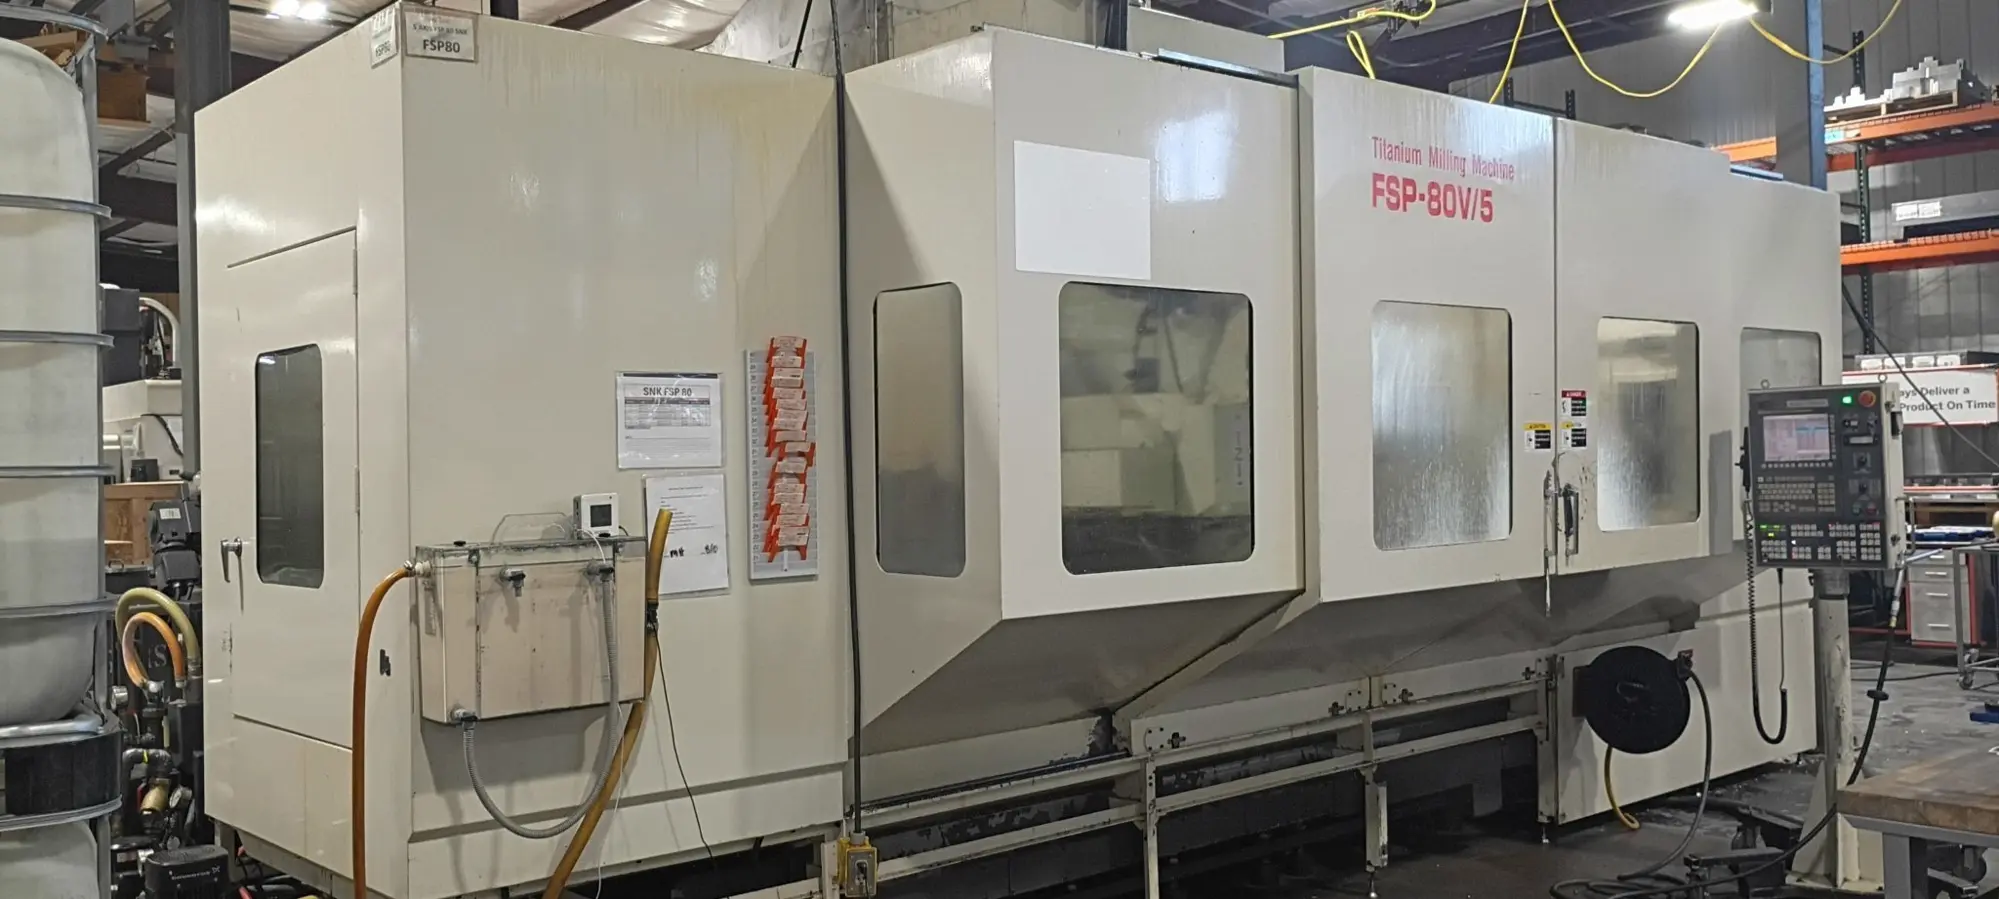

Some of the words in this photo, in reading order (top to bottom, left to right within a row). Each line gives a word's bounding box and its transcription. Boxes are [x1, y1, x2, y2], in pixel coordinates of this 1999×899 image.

[423, 39, 461, 53] FSP80
[1371, 136, 1422, 166] Titanium
[1428, 145, 1466, 178] Milling
[1472, 154, 1515, 182] Machine
[1371, 172, 1494, 224] FSP-80V/5
[643, 386, 662, 396] SNK
[664, 387, 680, 396] FSP
[1899, 389, 1917, 398] ays
[1920, 386, 1960, 396] Deliver
[1900, 401, 1943, 412] Product
[1947, 401, 1963, 410] On
[1965, 400, 1996, 410] Time
